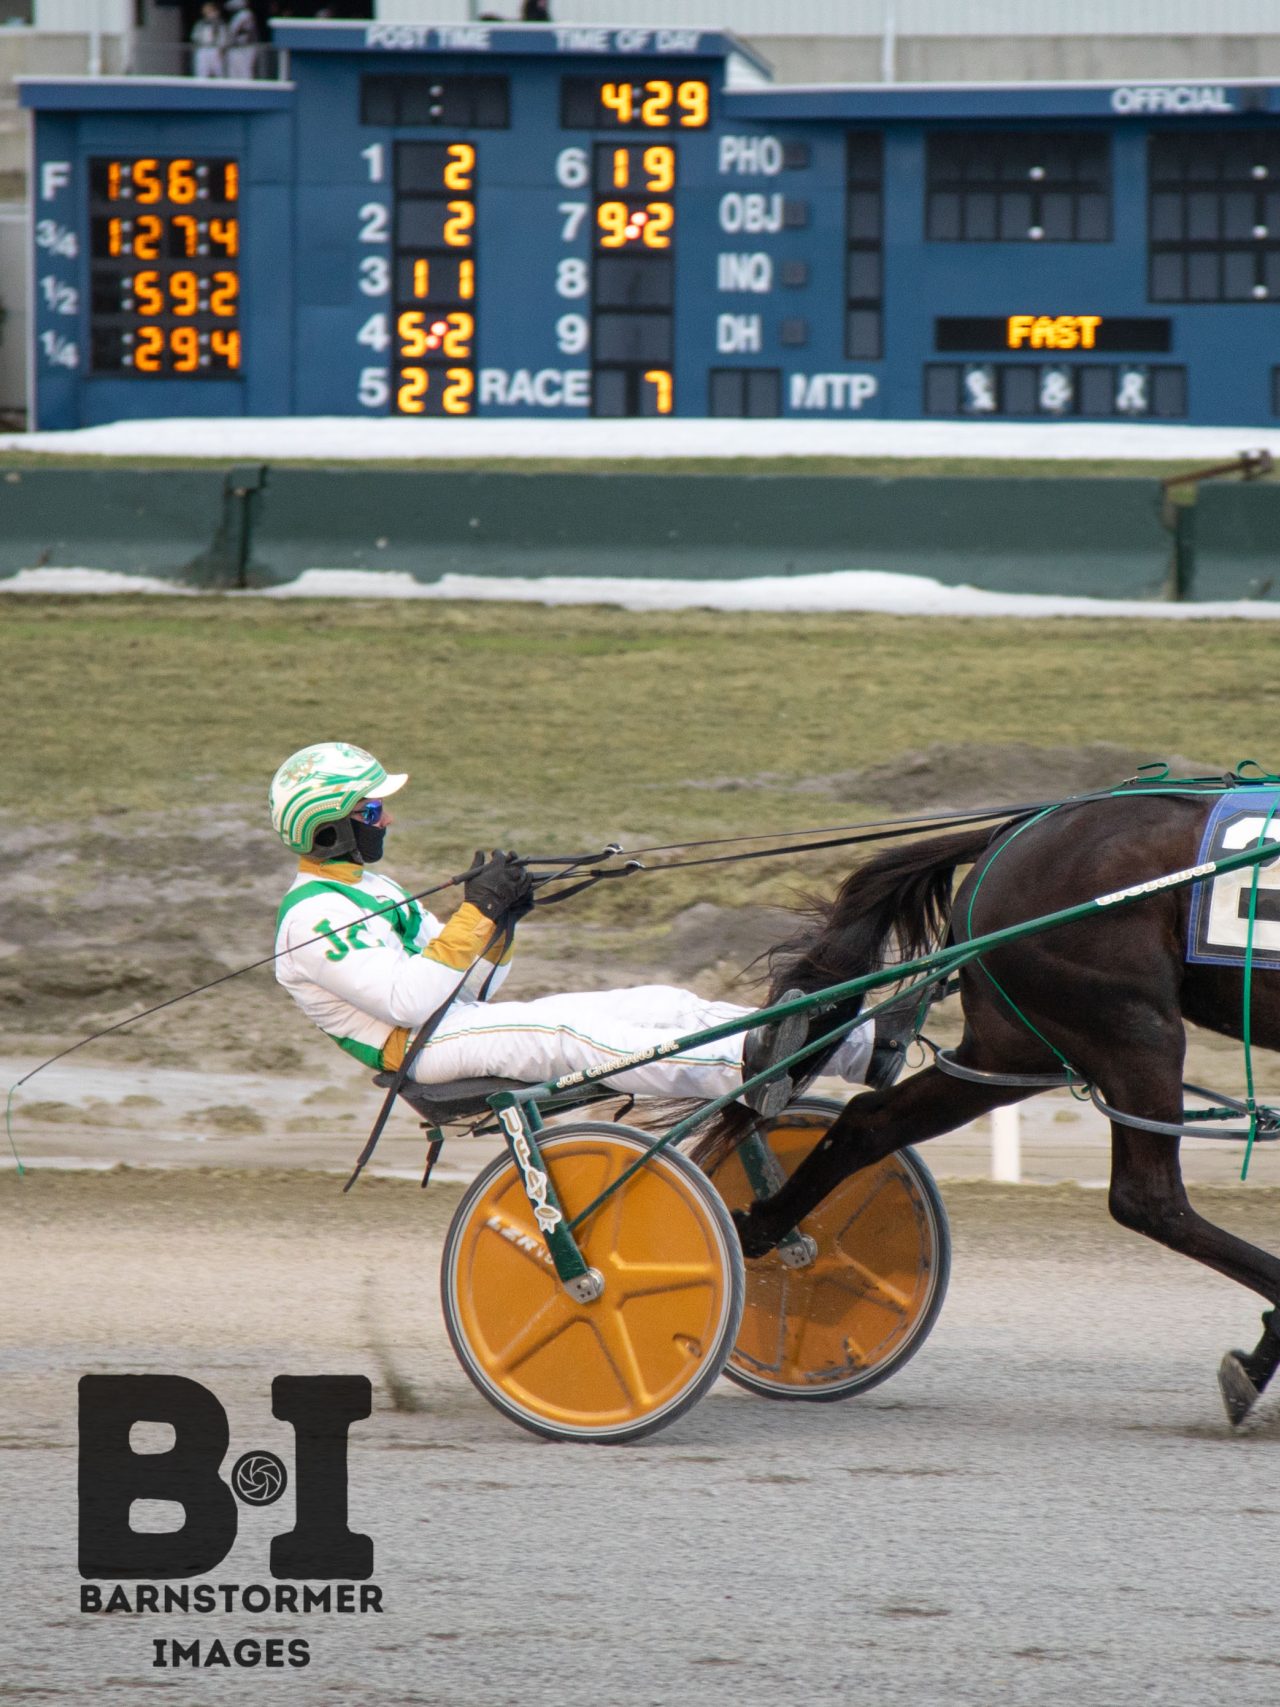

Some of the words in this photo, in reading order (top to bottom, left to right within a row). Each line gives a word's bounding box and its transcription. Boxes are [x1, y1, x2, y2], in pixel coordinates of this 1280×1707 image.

[365, 29, 428, 49] POST
[436, 29, 491, 49] TIME
[552, 30, 611, 51] TIME
[614, 30, 650, 51] OF
[654, 30, 701, 51] DAY
[602, 80, 709, 127] 4:29
[1111, 87, 1234, 113] OFFICIAL
[362, 144, 384, 182] 1
[443, 144, 475, 191] 2
[556, 148, 589, 188] 6
[613, 146, 675, 193] 19
[719, 135, 784, 175] PHO
[41, 162, 70, 200] F
[359, 203, 389, 243] 2
[443, 200, 475, 247] 2
[558, 202, 587, 241] 7
[719, 193, 784, 233] OBJ
[359, 256, 389, 296] 3
[556, 258, 589, 298] 8
[718, 253, 773, 293] INQ
[358, 313, 390, 351] 4
[556, 314, 589, 354] 9
[717, 314, 761, 353] DH
[1007, 315, 1102, 349] FAST
[358, 367, 390, 406] 5
[397, 366, 474, 414] 22
[479, 369, 590, 406] RACE
[644, 369, 673, 413] 7
[790, 373, 877, 409] MTP
[556, 1070, 585, 1088] JOE
